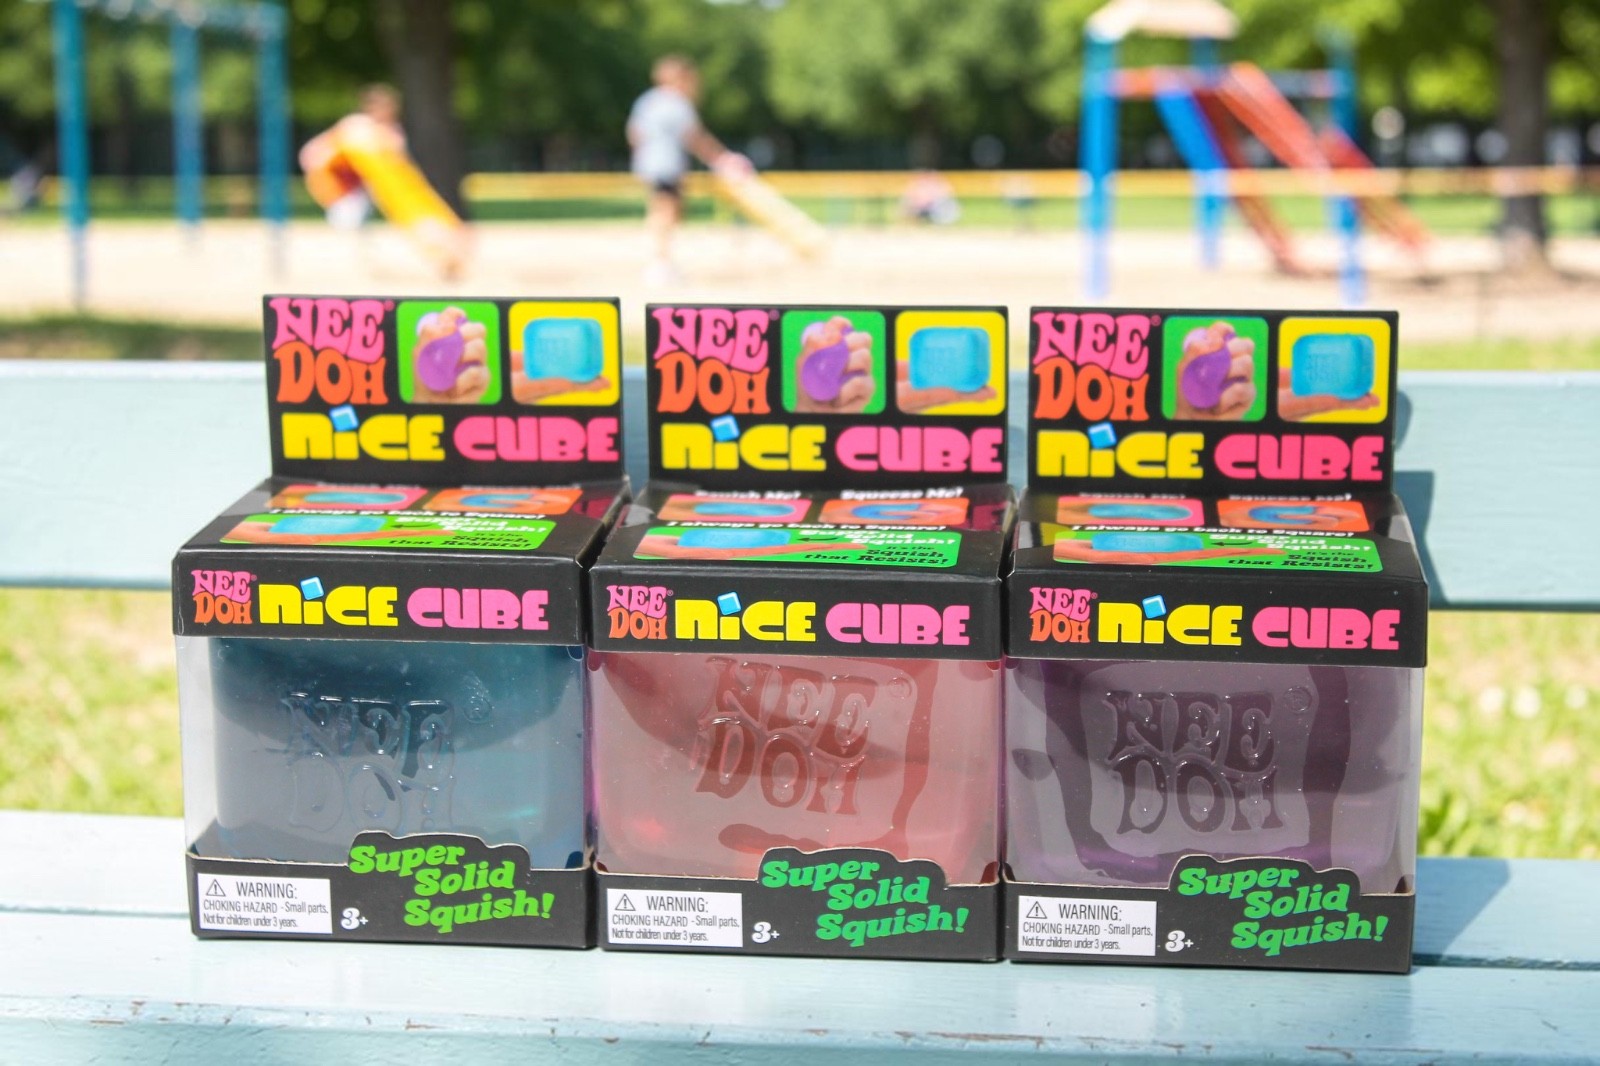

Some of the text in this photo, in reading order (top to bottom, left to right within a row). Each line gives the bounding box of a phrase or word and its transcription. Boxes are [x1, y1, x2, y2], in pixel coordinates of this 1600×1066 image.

[268, 297, 387, 364] NEE
[651, 307, 769, 374] NEE
[1031, 311, 1150, 380] NEE
[273, 341, 388, 405] DOH
[655, 350, 771, 414] DOH
[1033, 357, 1149, 421] DOH
[453, 416, 619, 463] CUBE
[835, 426, 1003, 473] CUBE
[1213, 434, 1384, 481] CUBE
[191, 569, 252, 604] NEE
[606, 585, 667, 619] NEE
[1029, 587, 1090, 621] NEE
[192, 592, 252, 625] DOH
[407, 587, 549, 630] CUBE
[608, 607, 667, 639] DOH
[826, 602, 970, 645] CUBE
[1030, 609, 1090, 642] DOH
[1252, 607, 1401, 650] CUBE
[699, 656, 879, 759] NEE
[1101, 690, 1276, 773] NEE
[690, 717, 859, 816] DOH
[1110, 754, 1284, 835] DOH
[348, 844, 465, 877] Super
[761, 860, 881, 892] Super
[236, 881, 297, 899] WARNING:
[415, 861, 515, 897] Solid
[826, 876, 931, 910] Solid
[1178, 867, 1300, 899] Super
[203, 900, 240, 912] CHOKING
[243, 902, 277, 913] HAZARD
[308, 903, 328, 915] parts.
[341, 908, 368, 930] 3+
[404, 889, 555, 933] Squish!
[646, 896, 708, 913] WARNING:
[1059, 904, 1121, 921] WARNING:
[1244, 884, 1351, 919] Solid
[203, 913, 298, 929] Not for children under 3 years.
[612, 914, 650, 926] CHOKING
[653, 916, 688, 927] HAZARD
[719, 917, 740, 929] parts.
[612, 928, 708, 943] Not for children under 3 years.
[752, 921, 779, 943] 3+
[816, 904, 969, 947] Squish!
[1023, 921, 1062, 934] CHOKING
[1065, 924, 1100, 935] HAZARD
[1132, 925, 1153, 938] parts.
[1231, 913, 1389, 957] Squish!
[1022, 936, 1120, 951] Not for children under 3 years.
[1165, 930, 1194, 952] 3+
